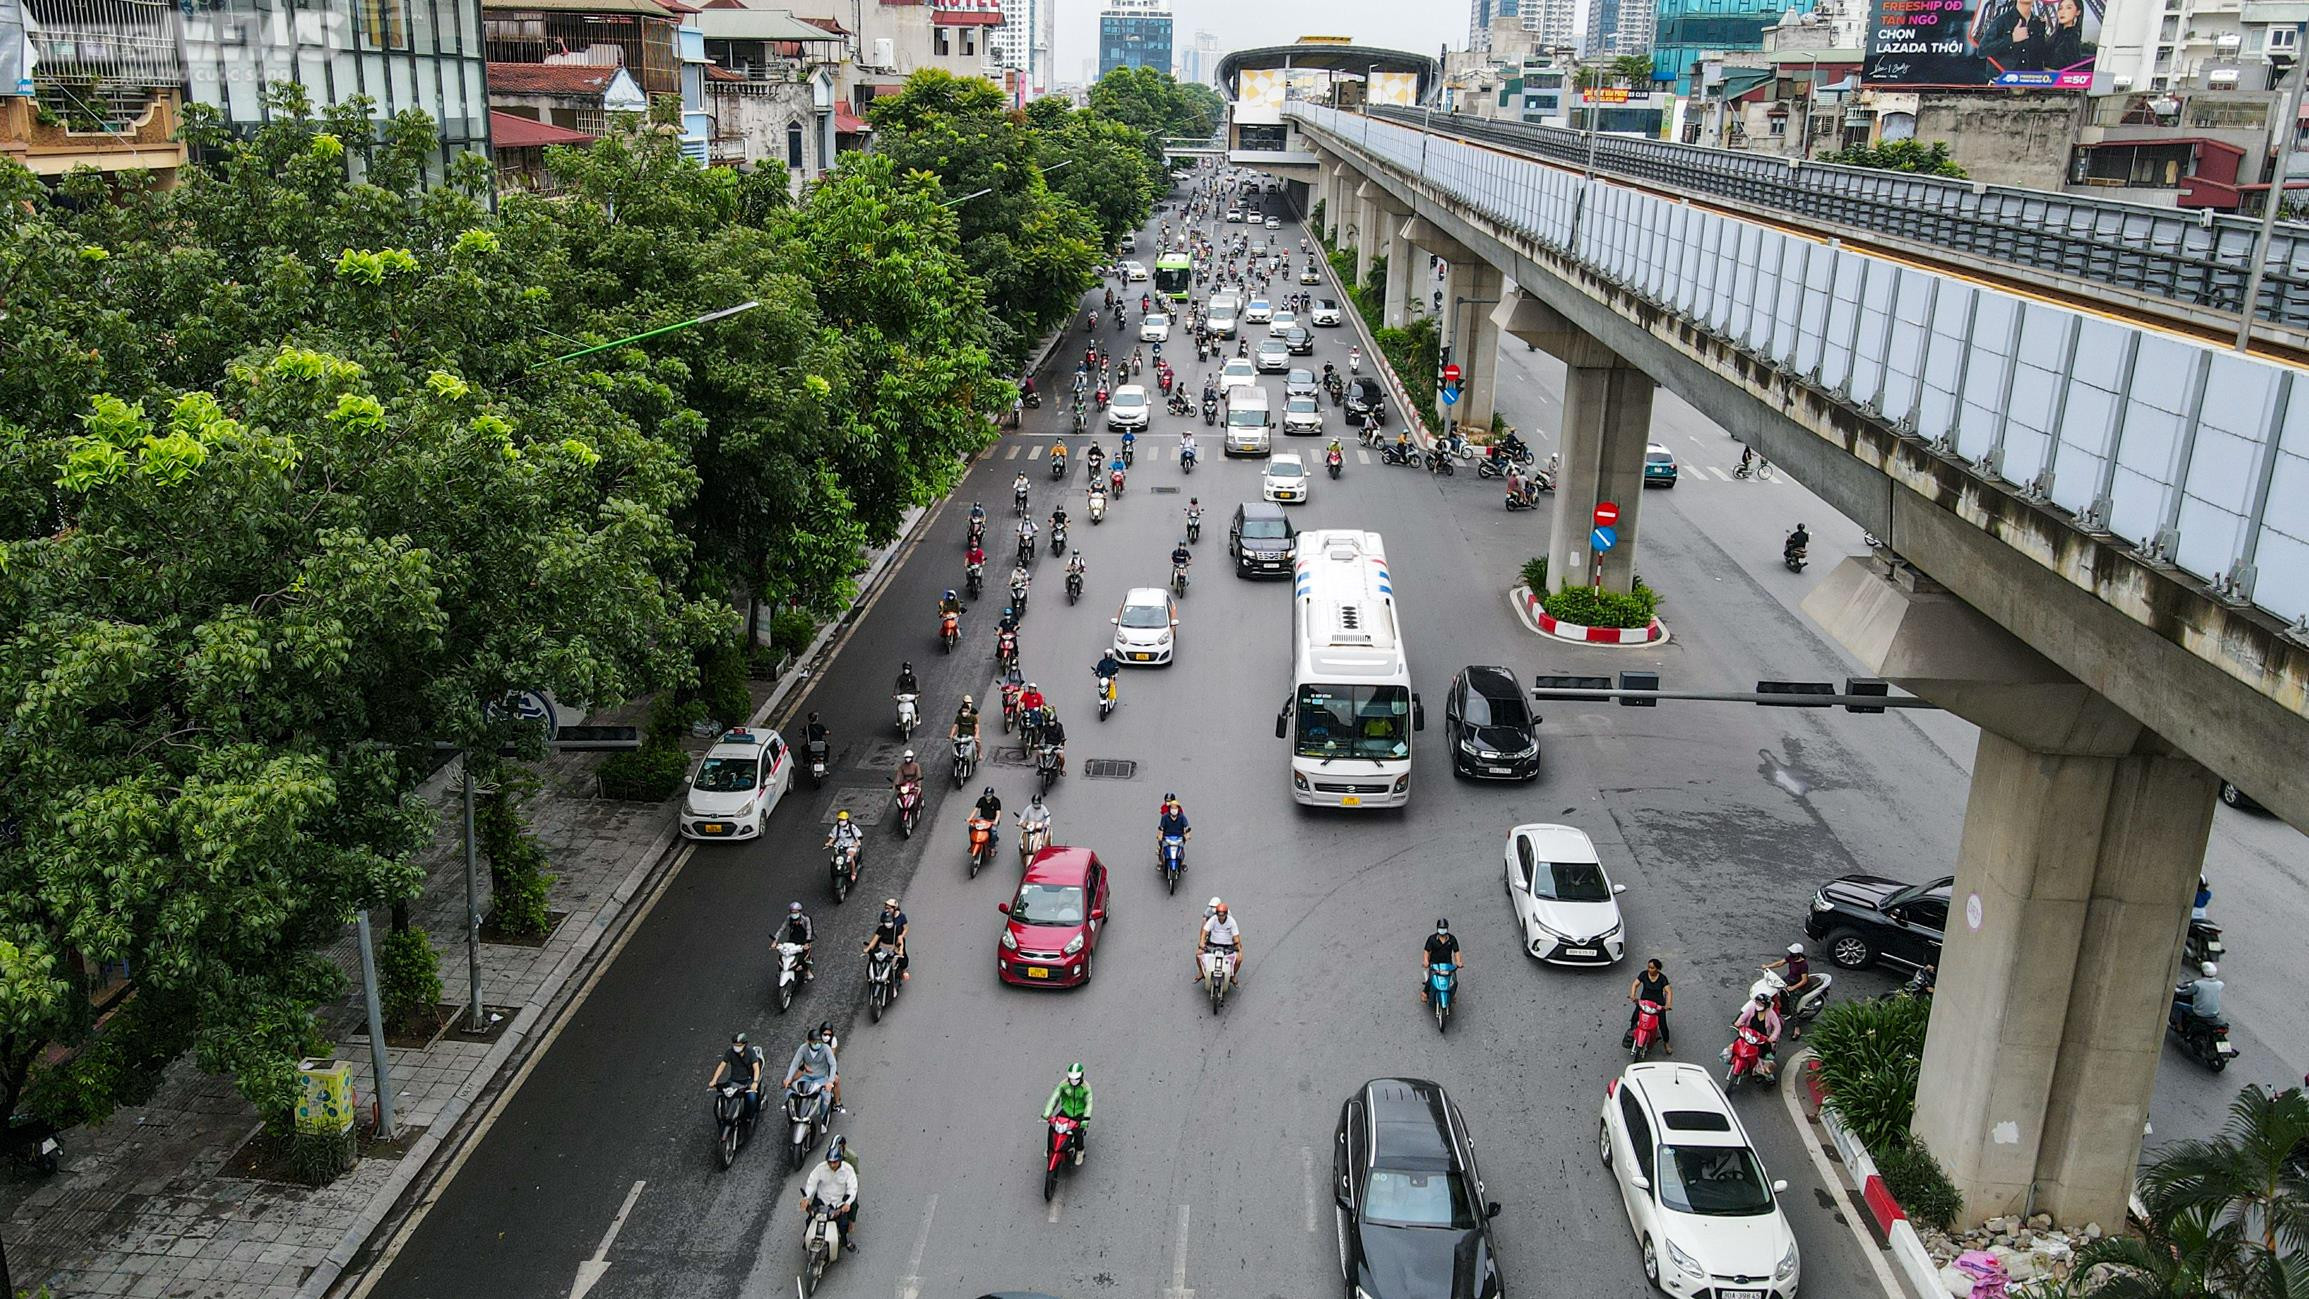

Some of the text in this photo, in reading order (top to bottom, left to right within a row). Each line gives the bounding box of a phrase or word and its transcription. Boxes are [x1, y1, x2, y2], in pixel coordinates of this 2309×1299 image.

[1882, 1, 1943, 11] FREESHIP
[1878, 29, 1916, 41] CHỌN
[1875, 40, 1964, 53] LAZADA THÔI
